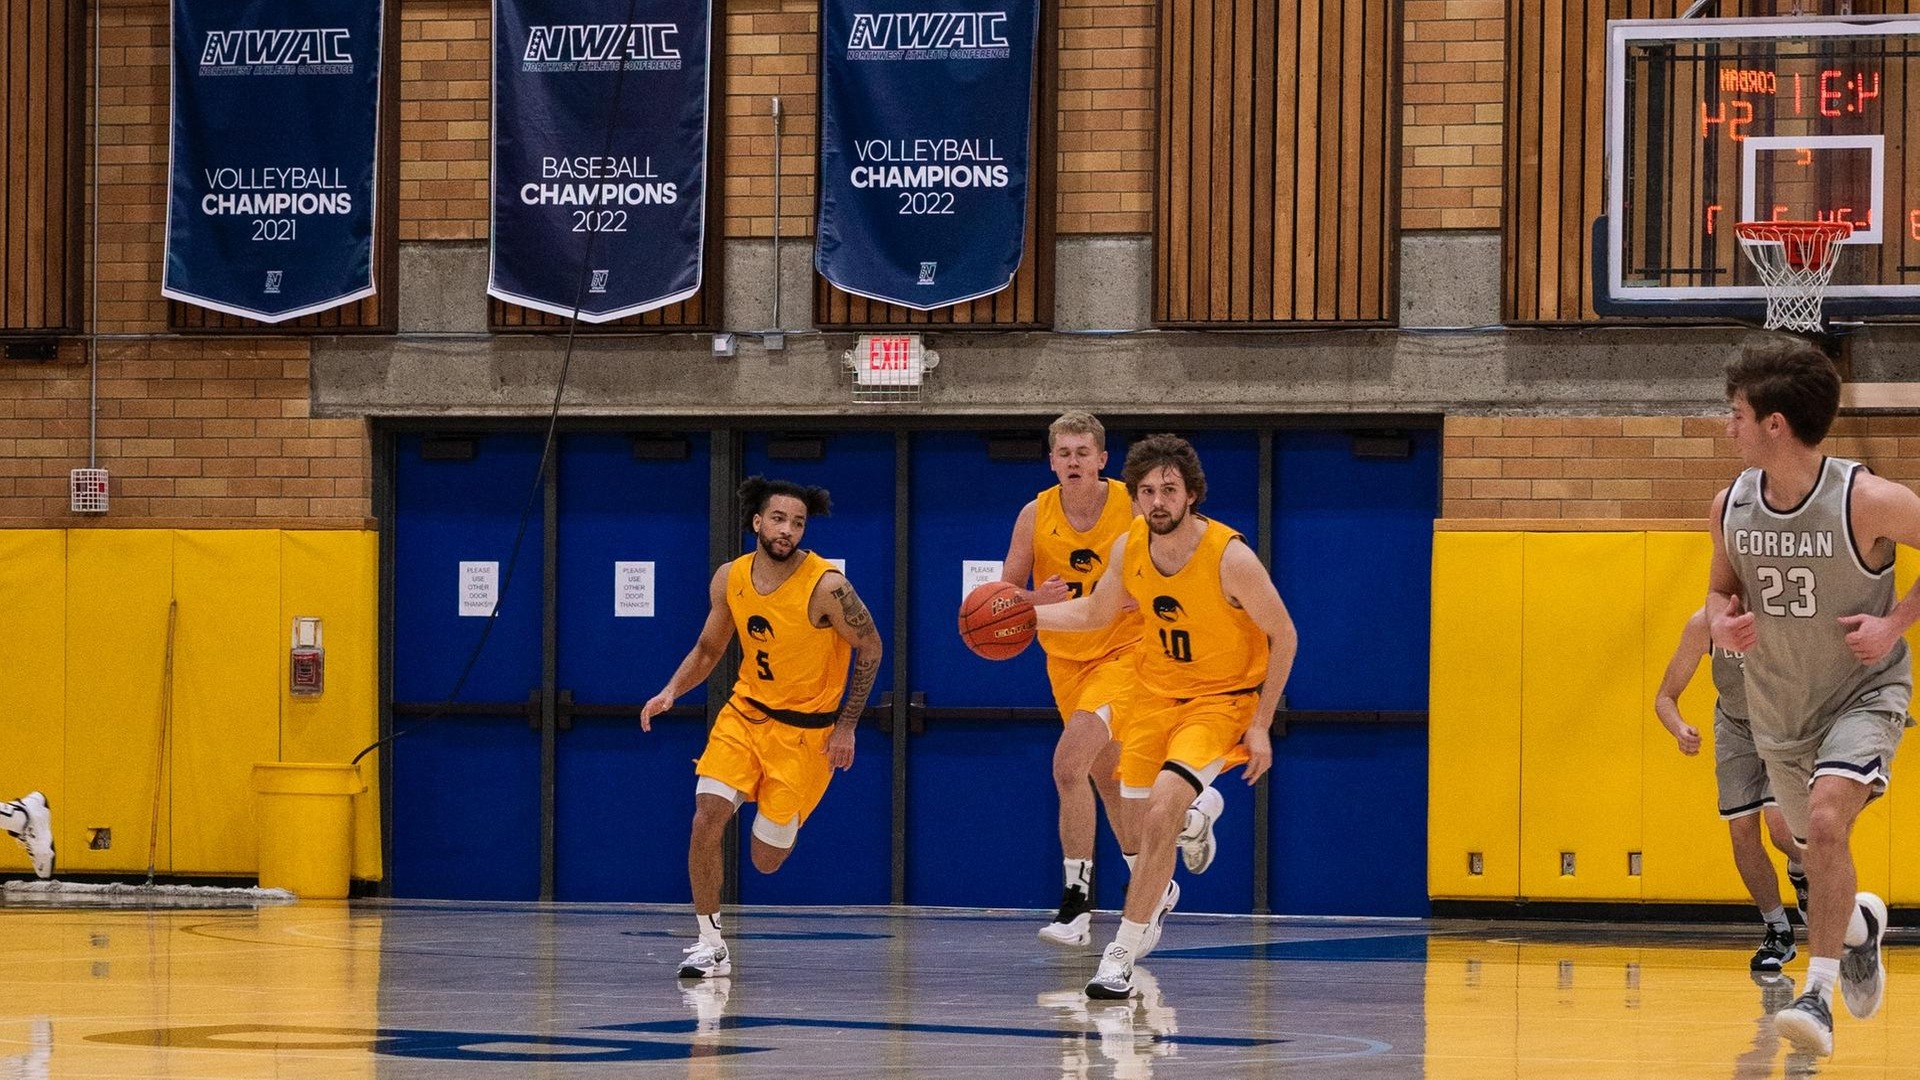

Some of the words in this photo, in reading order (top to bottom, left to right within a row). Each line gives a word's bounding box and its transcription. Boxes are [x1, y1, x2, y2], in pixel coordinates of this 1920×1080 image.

[847, 12, 1009, 49] NWAC
[200, 29, 353, 65] NWAC
[523, 24, 681, 61] NWAC
[522, 62, 577, 72] NORTHWEST
[578, 61, 620, 71] ATHLETIC
[622, 60, 681, 70] CONFERENCE
[847, 50, 904, 60] NORTHWEST
[905, 50, 949, 60] ATHLETIC
[950, 49, 1009, 59] CONFERENCE
[199, 66, 251, 75] NORTHWEST
[253, 65, 296, 75] ATHLETIC
[297, 64, 354, 75] CONFERENCE
[854, 139, 1003, 162] VOLLEYBALL
[205, 167, 347, 189] VOLLEYBALL
[542, 156, 658, 179] BASEBALL
[851, 165, 1009, 188] CHAMPIONS
[202, 193, 352, 215] CHAMPIONS
[520, 182, 678, 205] CHAMPIONS
[898, 192, 955, 215] 2022
[251, 218, 296, 241] 2021
[572, 210, 627, 232] 2022
[870, 337, 911, 370] EXIT
[1734, 529, 1834, 558] CORBAN
[1756, 566, 1818, 619] 23
[1159, 627, 1192, 663] 10
[756, 649, 774, 681] 5
